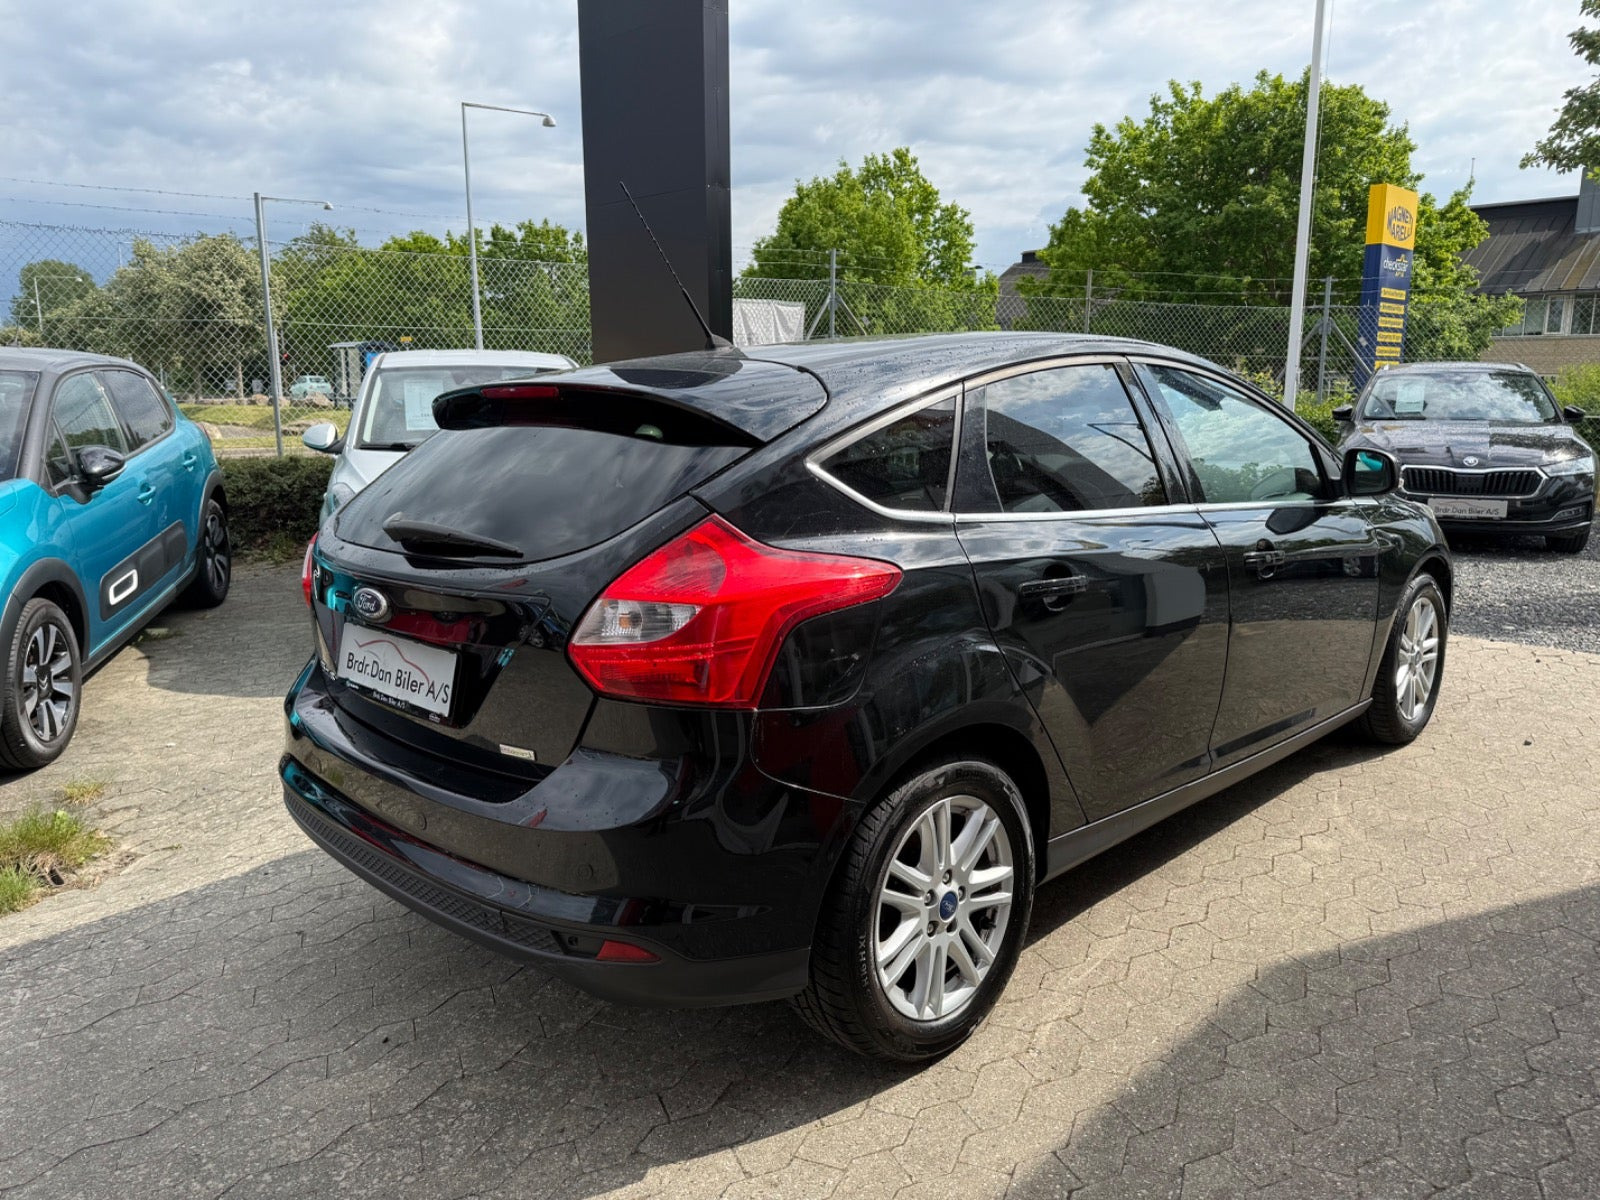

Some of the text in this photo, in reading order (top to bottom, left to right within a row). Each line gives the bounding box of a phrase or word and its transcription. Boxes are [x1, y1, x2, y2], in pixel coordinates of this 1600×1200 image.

[357, 592, 377, 612] Ford
[394, 669, 425, 695] Biler
[426, 680, 450, 704] A/S
